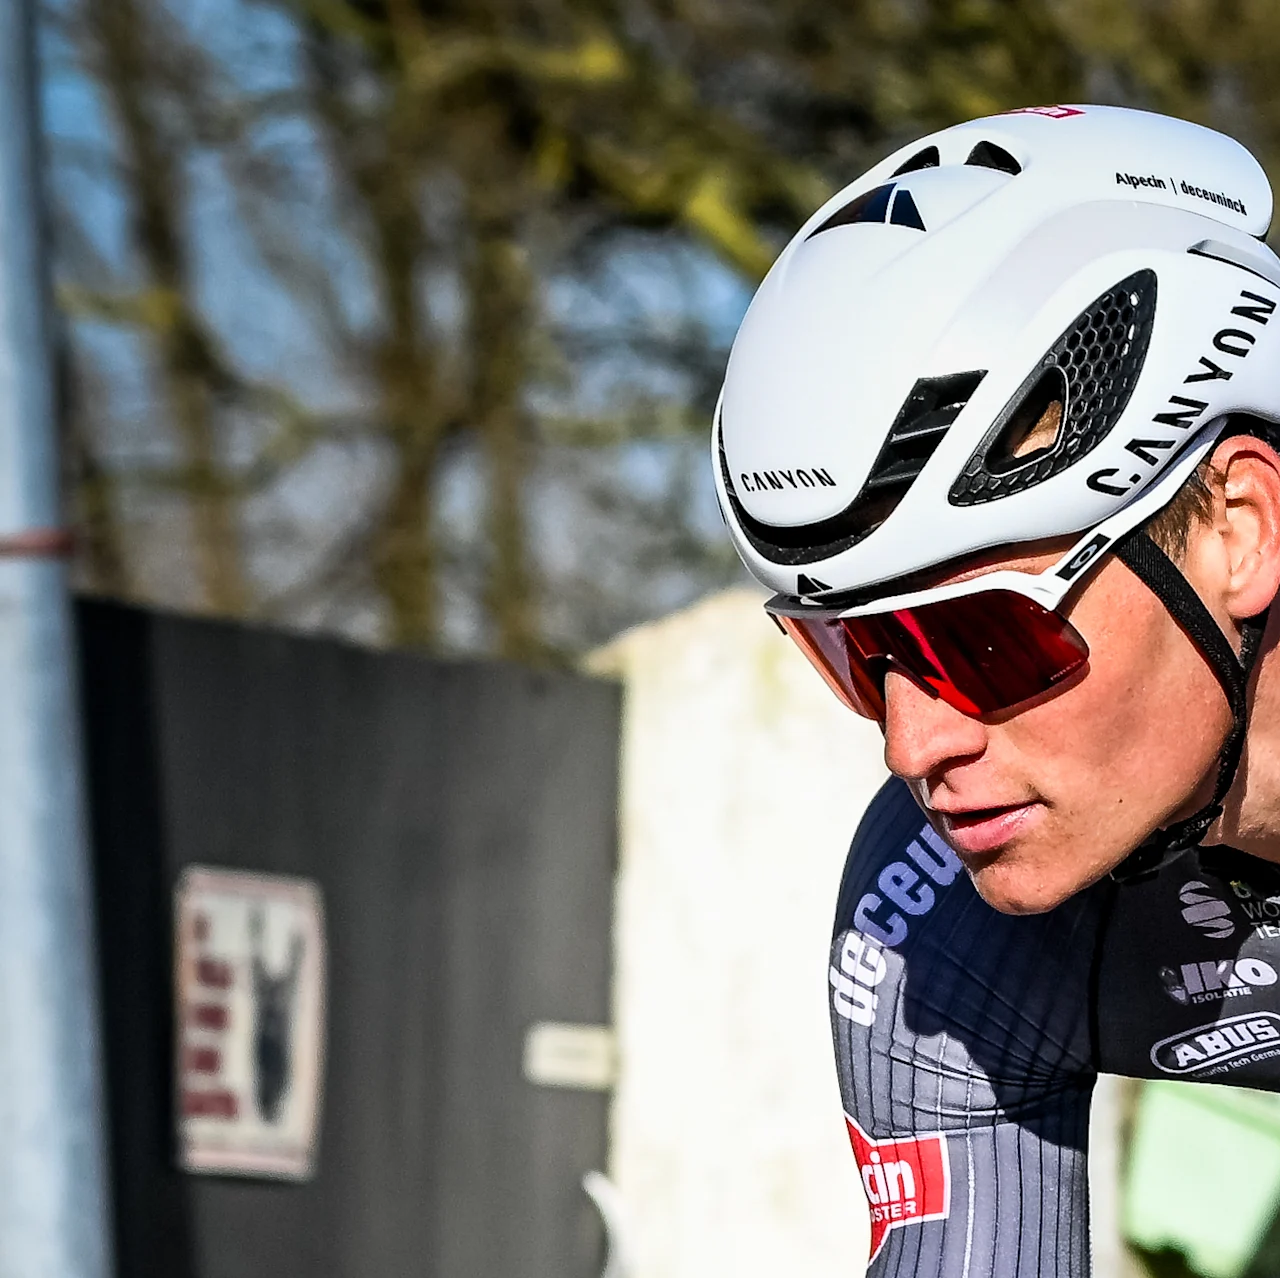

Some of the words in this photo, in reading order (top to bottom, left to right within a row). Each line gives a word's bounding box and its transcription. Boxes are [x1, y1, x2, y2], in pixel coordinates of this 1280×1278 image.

[1115, 172, 1166, 190] Alpecin
[1180, 180, 1248, 216] deceuninck
[1086, 290, 1278, 497] CANYON
[741, 466, 838, 494] CANYON
[1180, 957, 1278, 995] IKO
[1192, 986, 1253, 1005] ISOLATIE
[1173, 1018, 1280, 1068] ABUS
